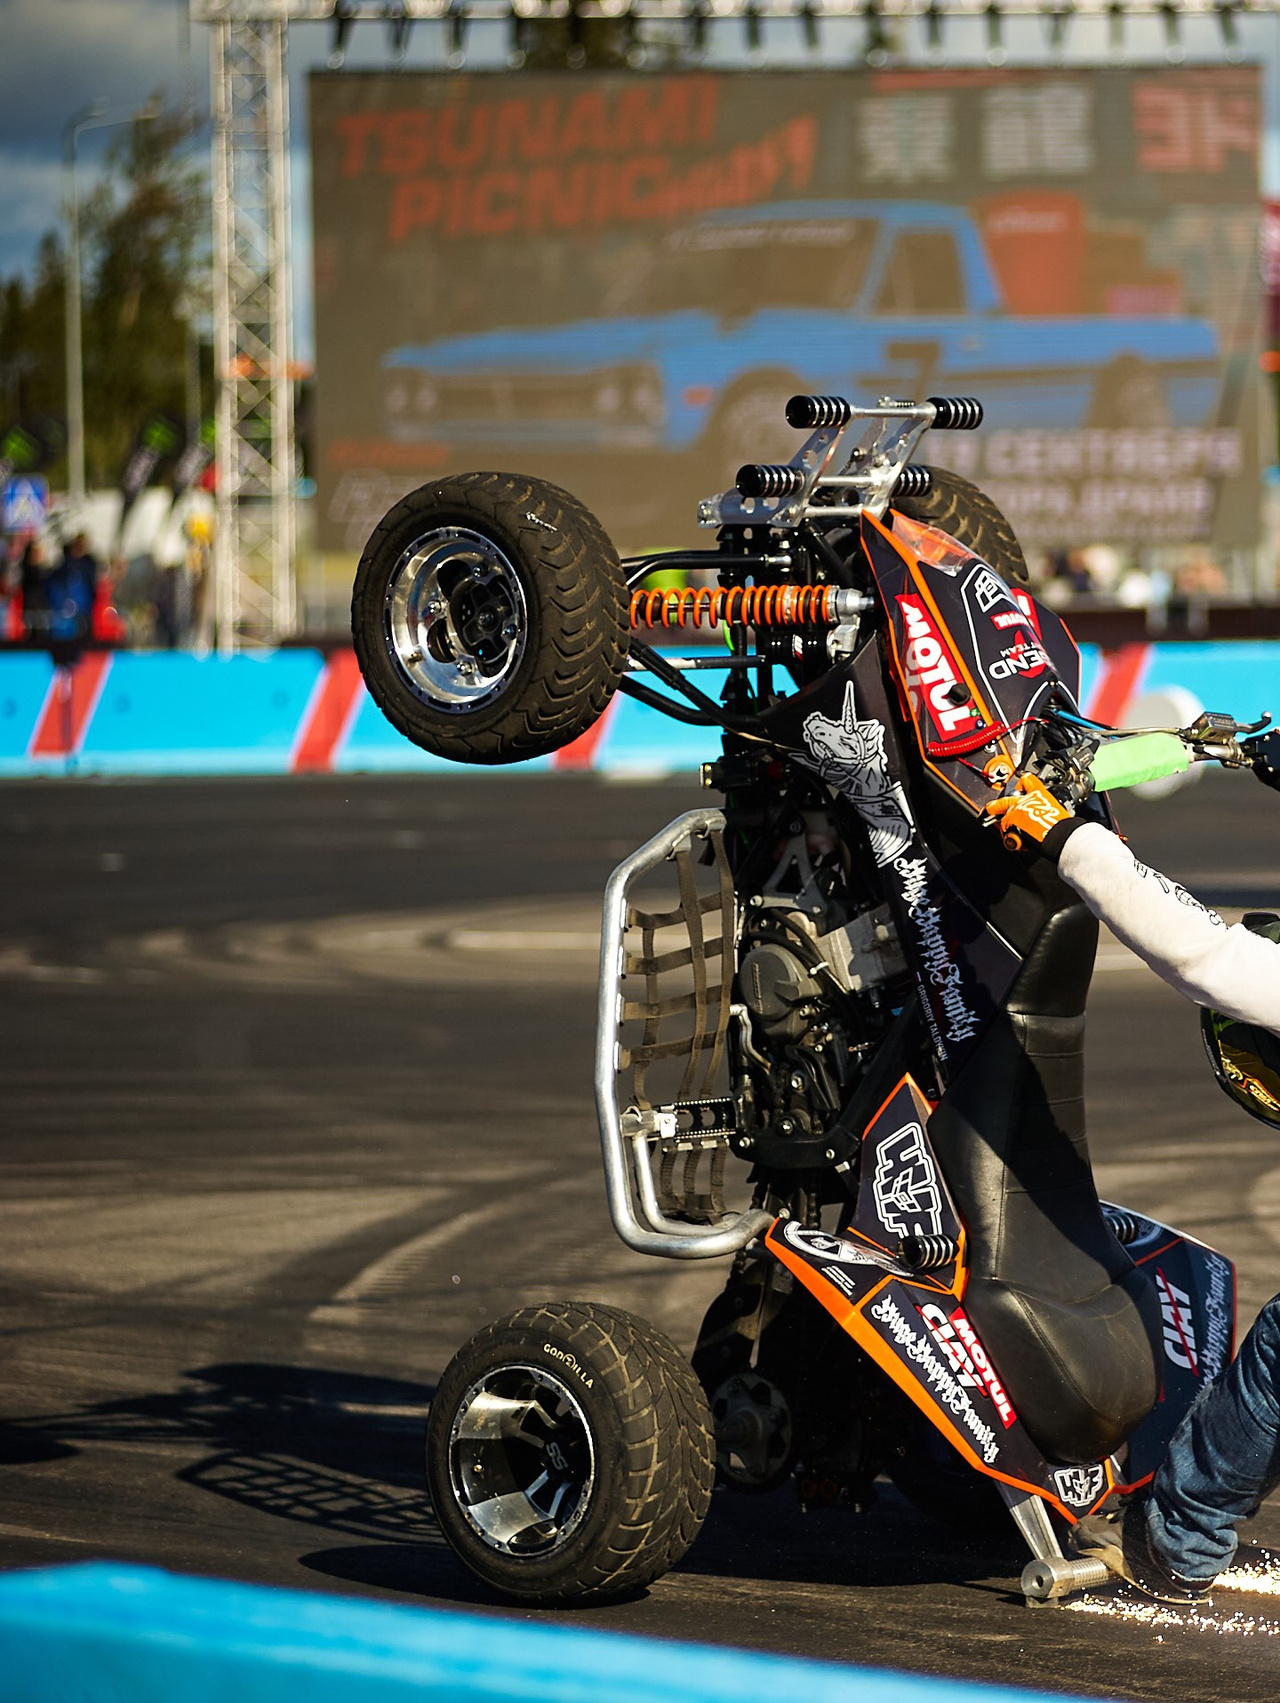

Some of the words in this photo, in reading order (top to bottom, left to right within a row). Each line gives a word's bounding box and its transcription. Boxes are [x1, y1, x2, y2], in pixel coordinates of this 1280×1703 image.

[337, 77, 718, 178] TSUNAMI
[389, 154, 672, 242] PICNIC
[900, 600, 973, 732] MOTUL
[917, 984, 934, 1025] GRIGORIY
[543, 1343, 595, 1390] GODZILLA
[952, 1318, 1014, 1422] MOTUL
[949, 1384, 1000, 1464] Family
